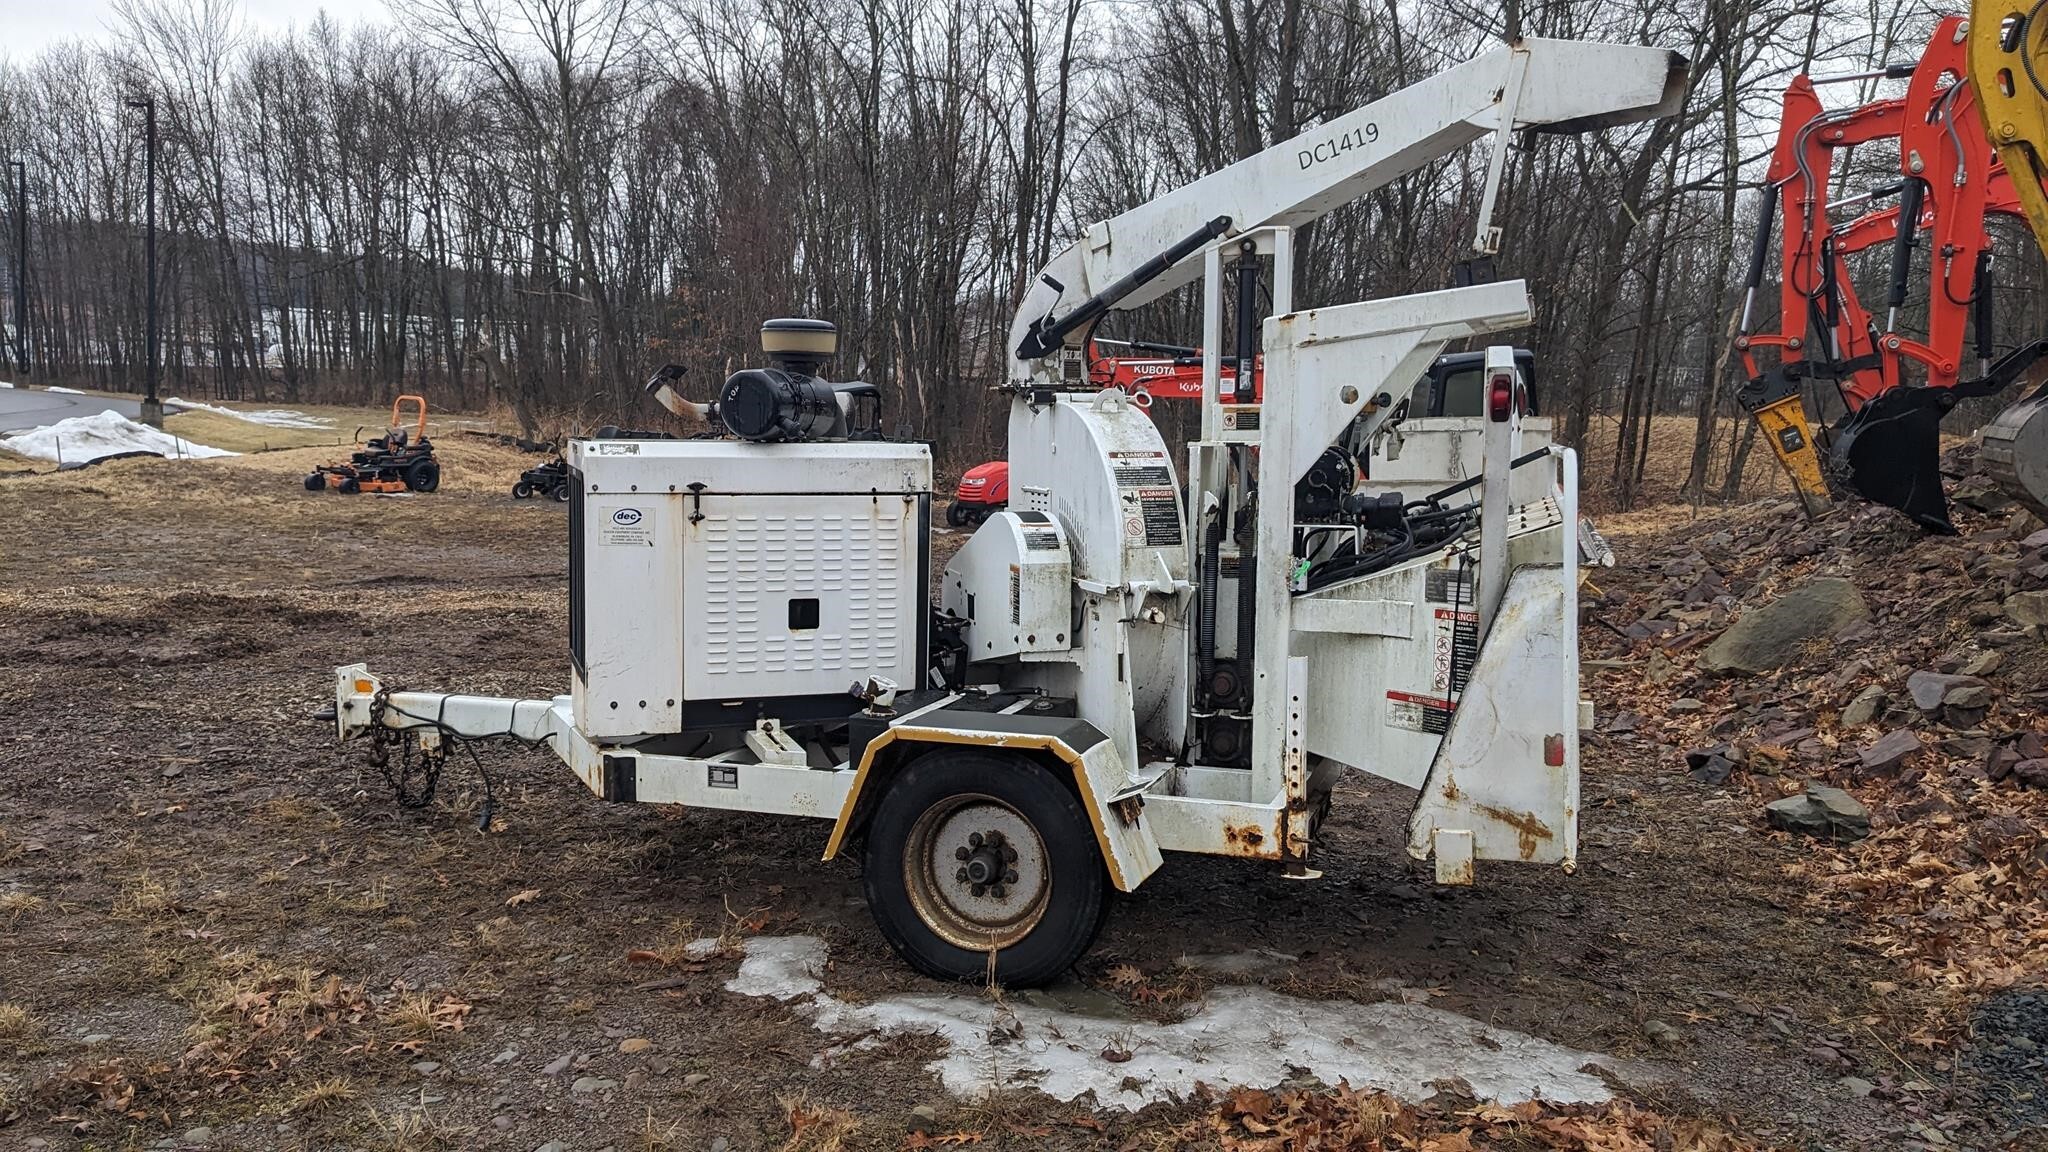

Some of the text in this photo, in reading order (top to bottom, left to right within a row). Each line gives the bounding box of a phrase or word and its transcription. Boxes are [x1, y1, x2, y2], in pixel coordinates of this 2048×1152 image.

[1297, 122, 1379, 171] DC1419
[1133, 365, 1176, 376] KUBOTA
[1179, 382, 1204, 392] Kub
[616, 511, 637, 520] dec
[1449, 611, 1479, 622] DANGE
[1414, 696, 1440, 706] DANGER
